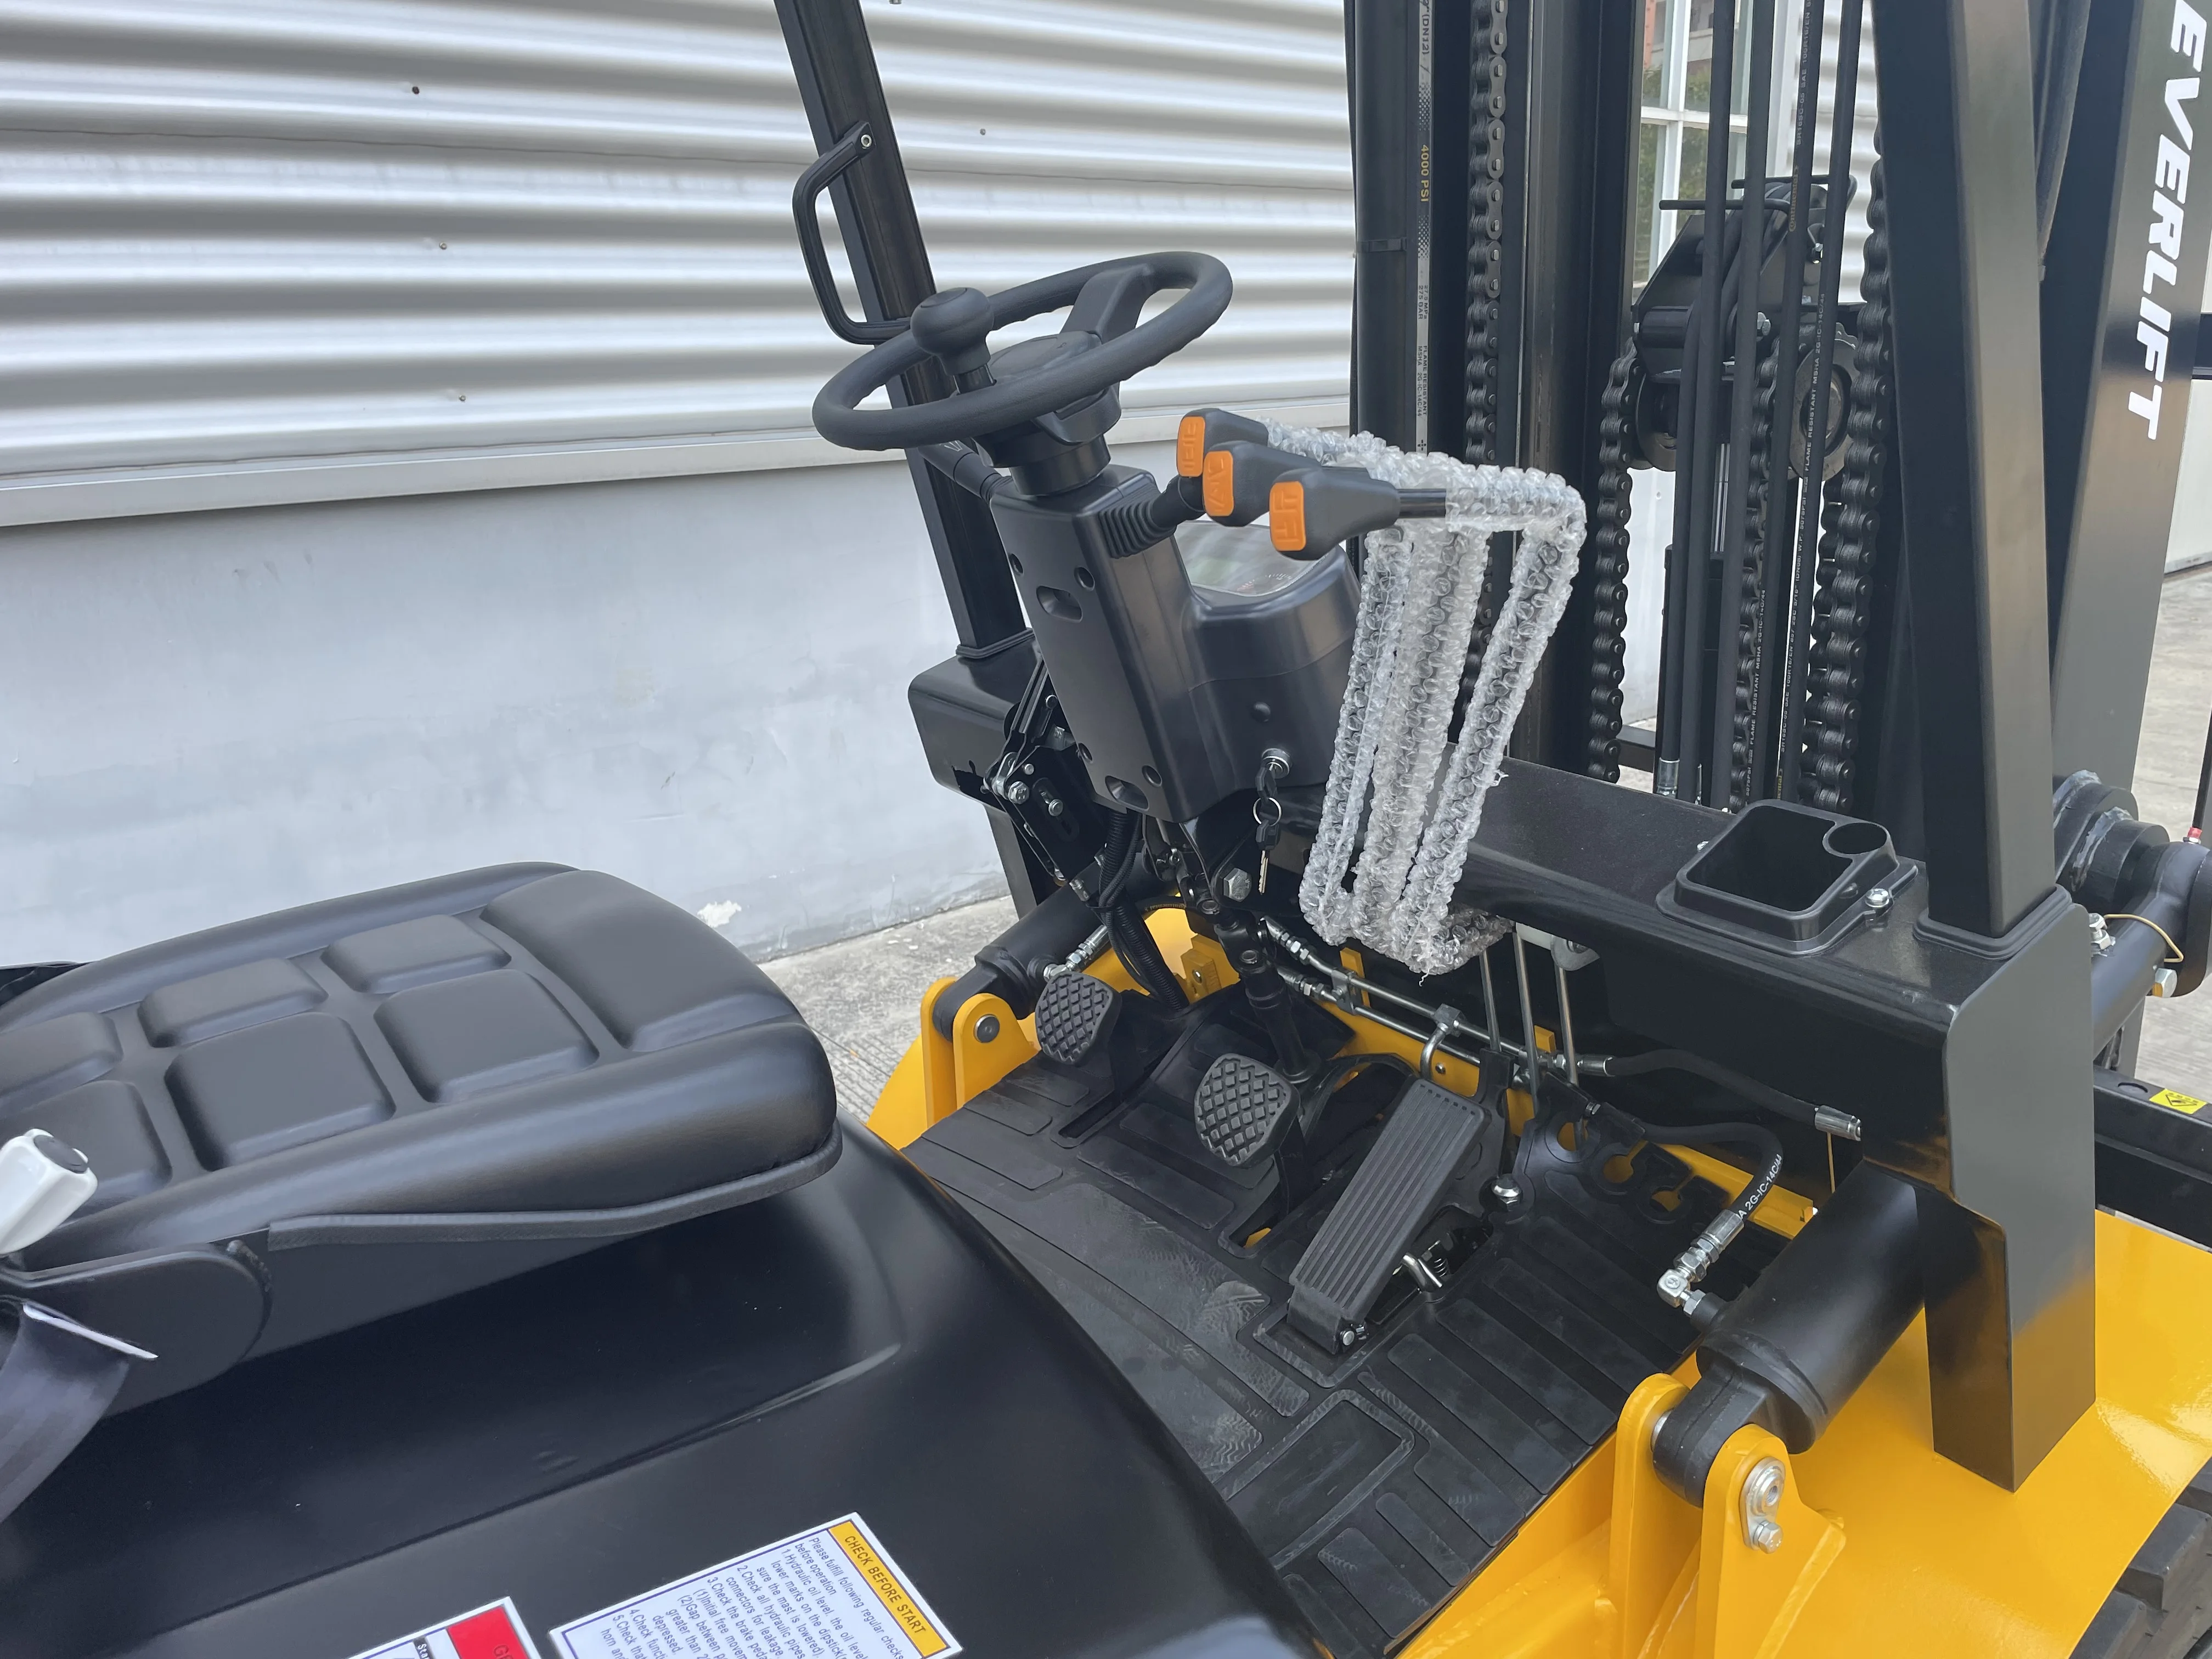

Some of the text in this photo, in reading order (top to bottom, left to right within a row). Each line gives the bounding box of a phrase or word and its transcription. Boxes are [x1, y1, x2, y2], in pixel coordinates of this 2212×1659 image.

[1420, 144, 1429, 202] 4000 PSI
[2128, 0, 2207, 441] EVERLIFT
[1808, 388, 1816, 438] RESISTANT
[1745, 1154, 1782, 1211] 2G-IC-14C/44
[757, 1567, 771, 1582] sure
[768, 1582, 781, 1596] the
[777, 1598, 795, 1616] mast
[791, 1614, 800, 1624] is
[770, 1560, 789, 1582] lower
[785, 1581, 804, 1602] marks
[800, 1604, 812, 1614] on
[809, 1613, 822, 1627] the
[794, 1543, 837, 1595] before operation
[844, 1536, 927, 1634] CHECK BEFORE START
[715, 1617, 729, 1634] free
[726, 1577, 755, 1613] connectors
[752, 1615, 764, 1627] for
[726, 1606, 740, 1620] the
[735, 1620, 754, 1642] brake
[757, 1594, 771, 1606] all
[764, 1604, 791, 1638] hydraulic
[785, 1636, 805, 1659] pipes
[808, 1586, 819, 1597] oil
[830, 1617, 843, 1632] the
[840, 1631, 854, 1644] oil
[809, 1537, 904, 1659] Please fulfill following regular checks
[600, 1628, 616, 1646] horn
[665, 1609, 690, 1640] greater
[685, 1635, 701, 1654] than
[696, 1620, 720, 1652] between
